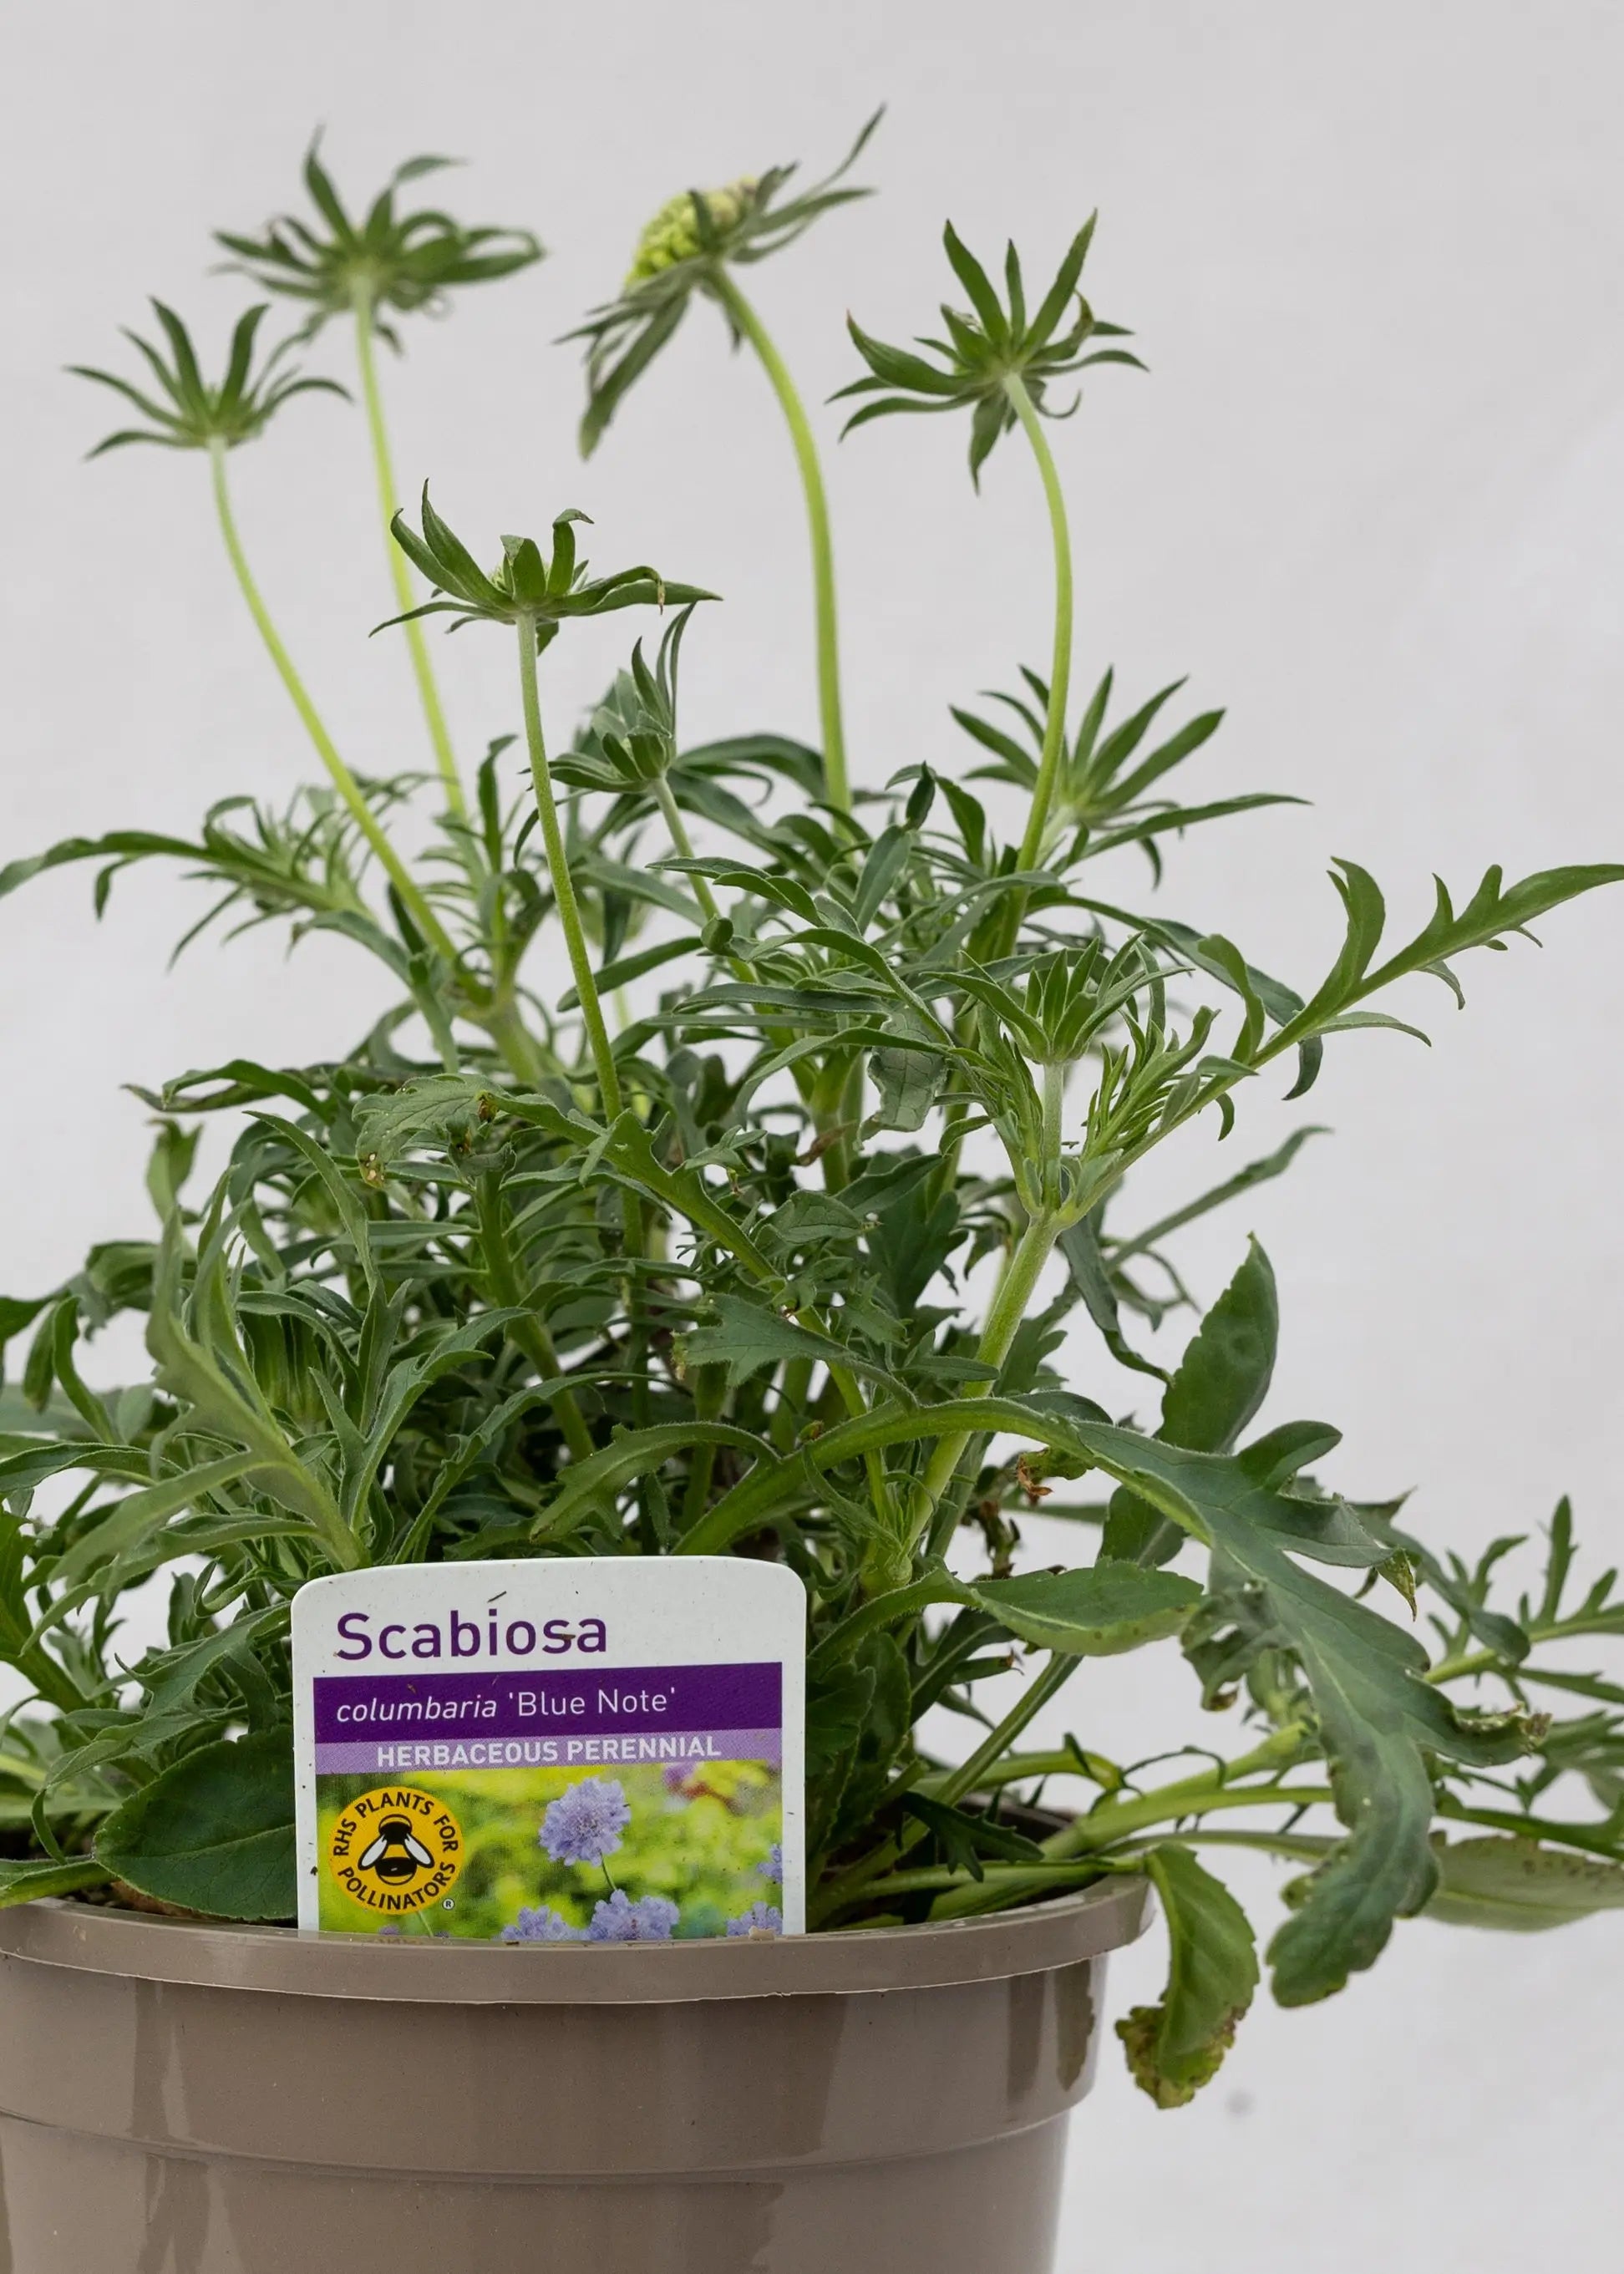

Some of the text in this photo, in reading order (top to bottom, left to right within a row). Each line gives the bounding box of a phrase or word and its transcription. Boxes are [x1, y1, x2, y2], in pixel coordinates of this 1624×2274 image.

[337, 1608, 607, 1660] Scabiosa
[336, 1687, 676, 1723] columbaria 'Blue Note'
[377, 1736, 721, 1767] HERBACEOUS PERENNIAL
[333, 1791, 459, 1856] RHS PLANTS FOR
[337, 1861, 456, 1911] POLLINATORS
